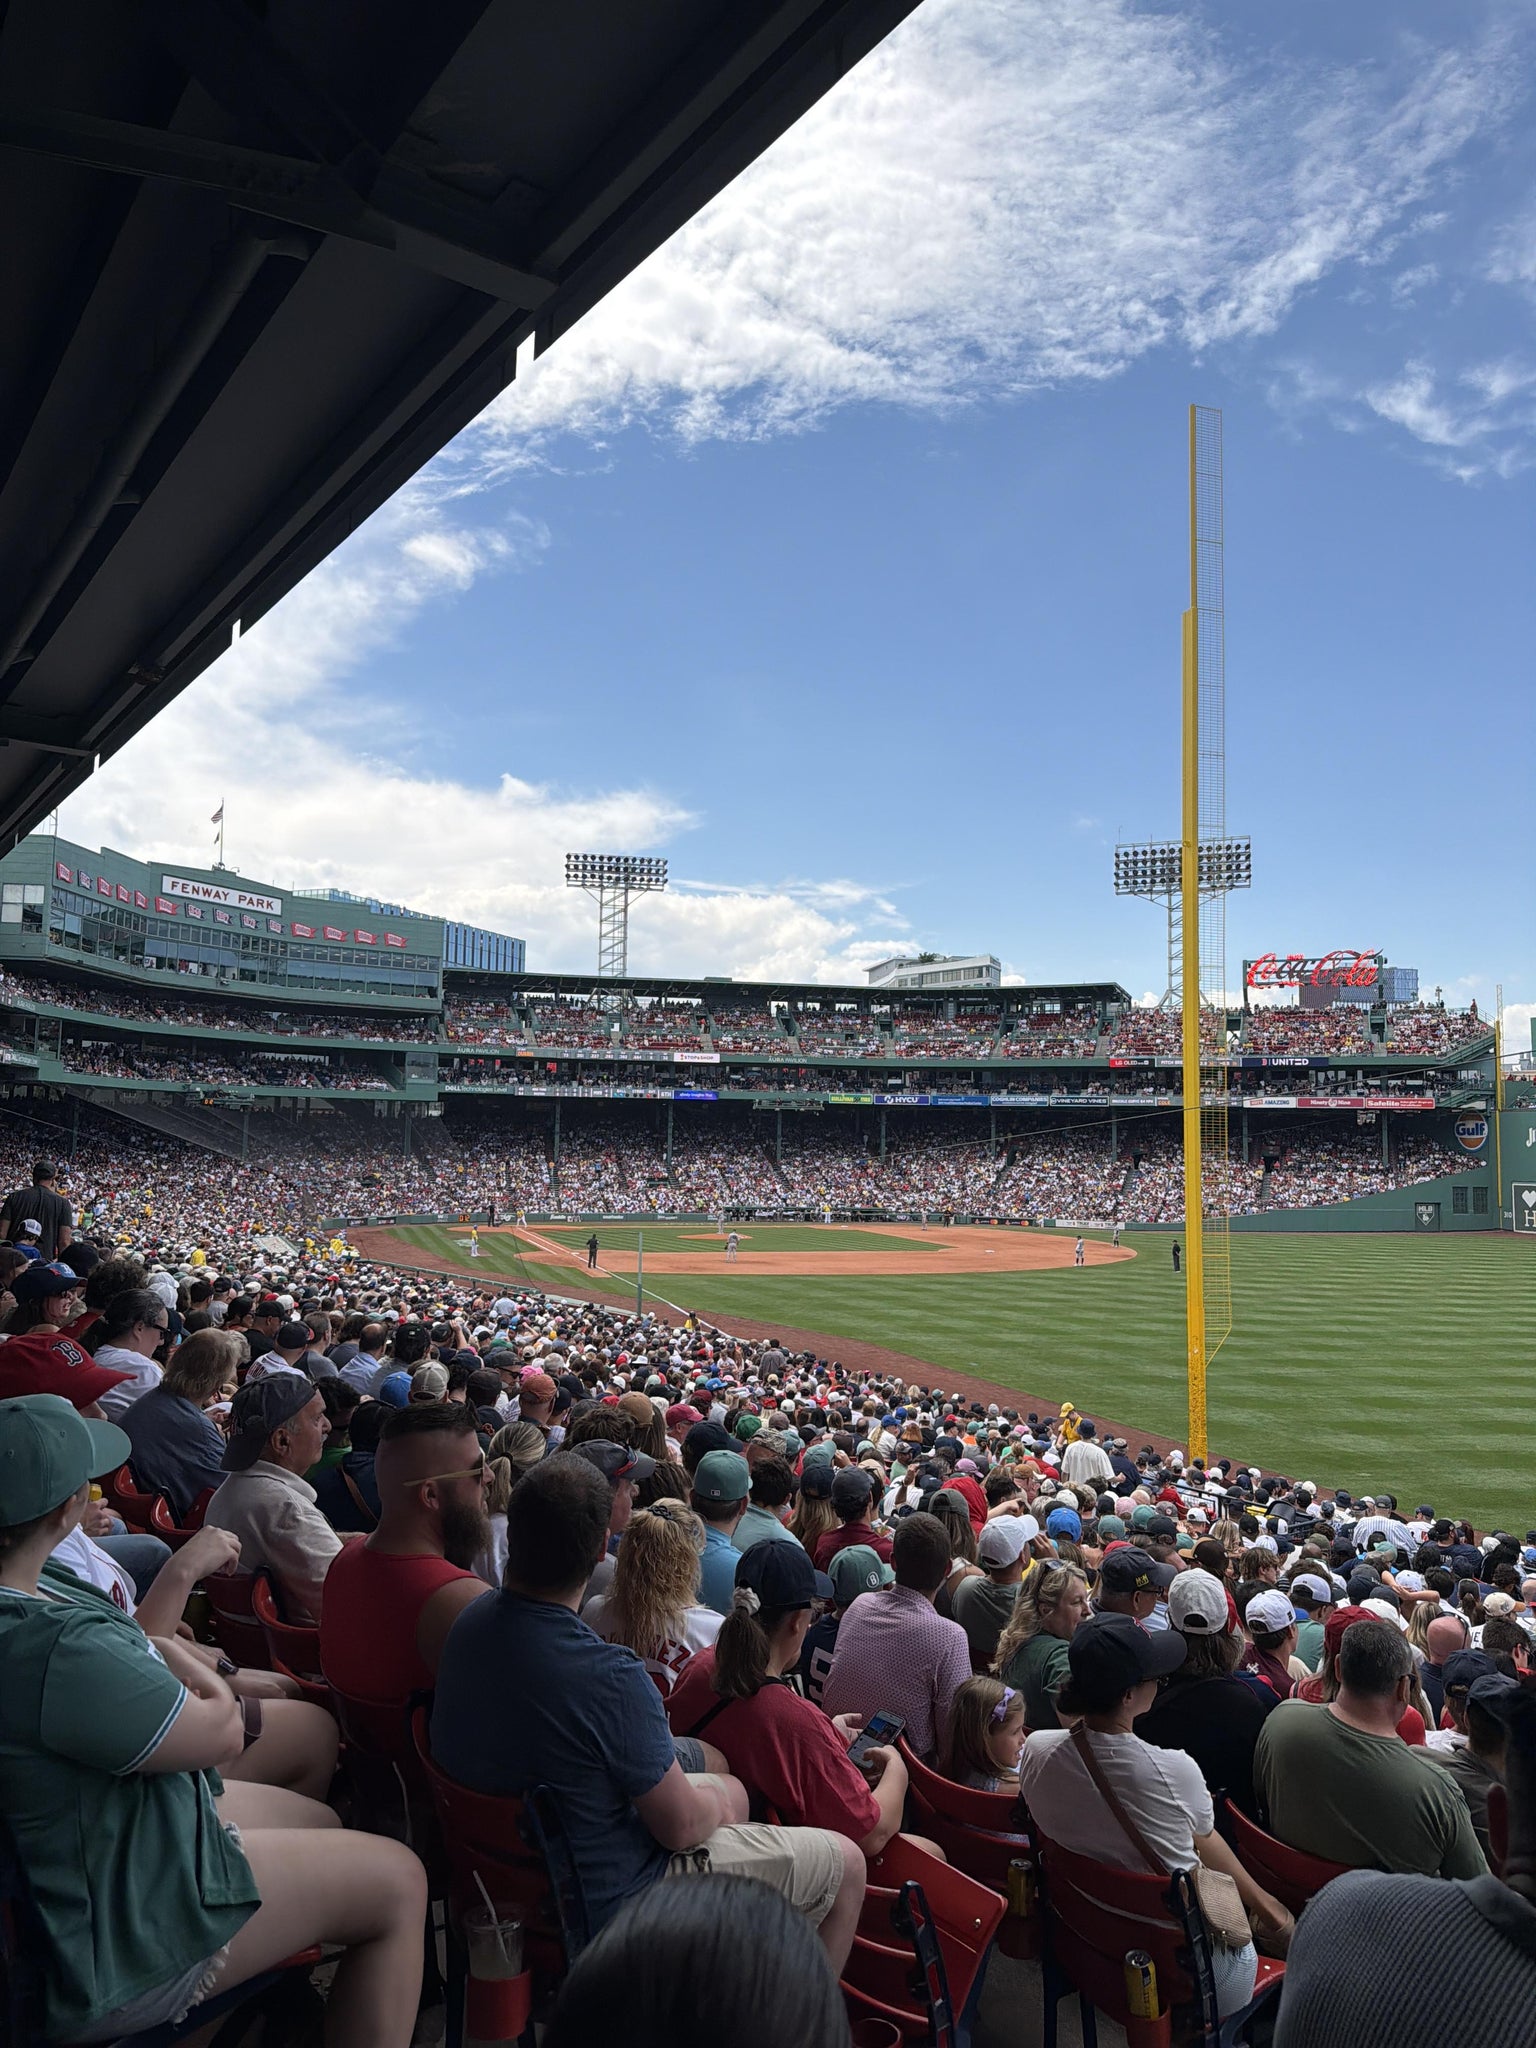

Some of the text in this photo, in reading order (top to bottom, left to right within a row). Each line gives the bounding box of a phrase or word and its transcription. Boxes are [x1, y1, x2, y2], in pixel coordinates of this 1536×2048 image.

[171, 881, 274, 911] FENWAY PARK
[1456, 1123, 1486, 1136] Gulf
